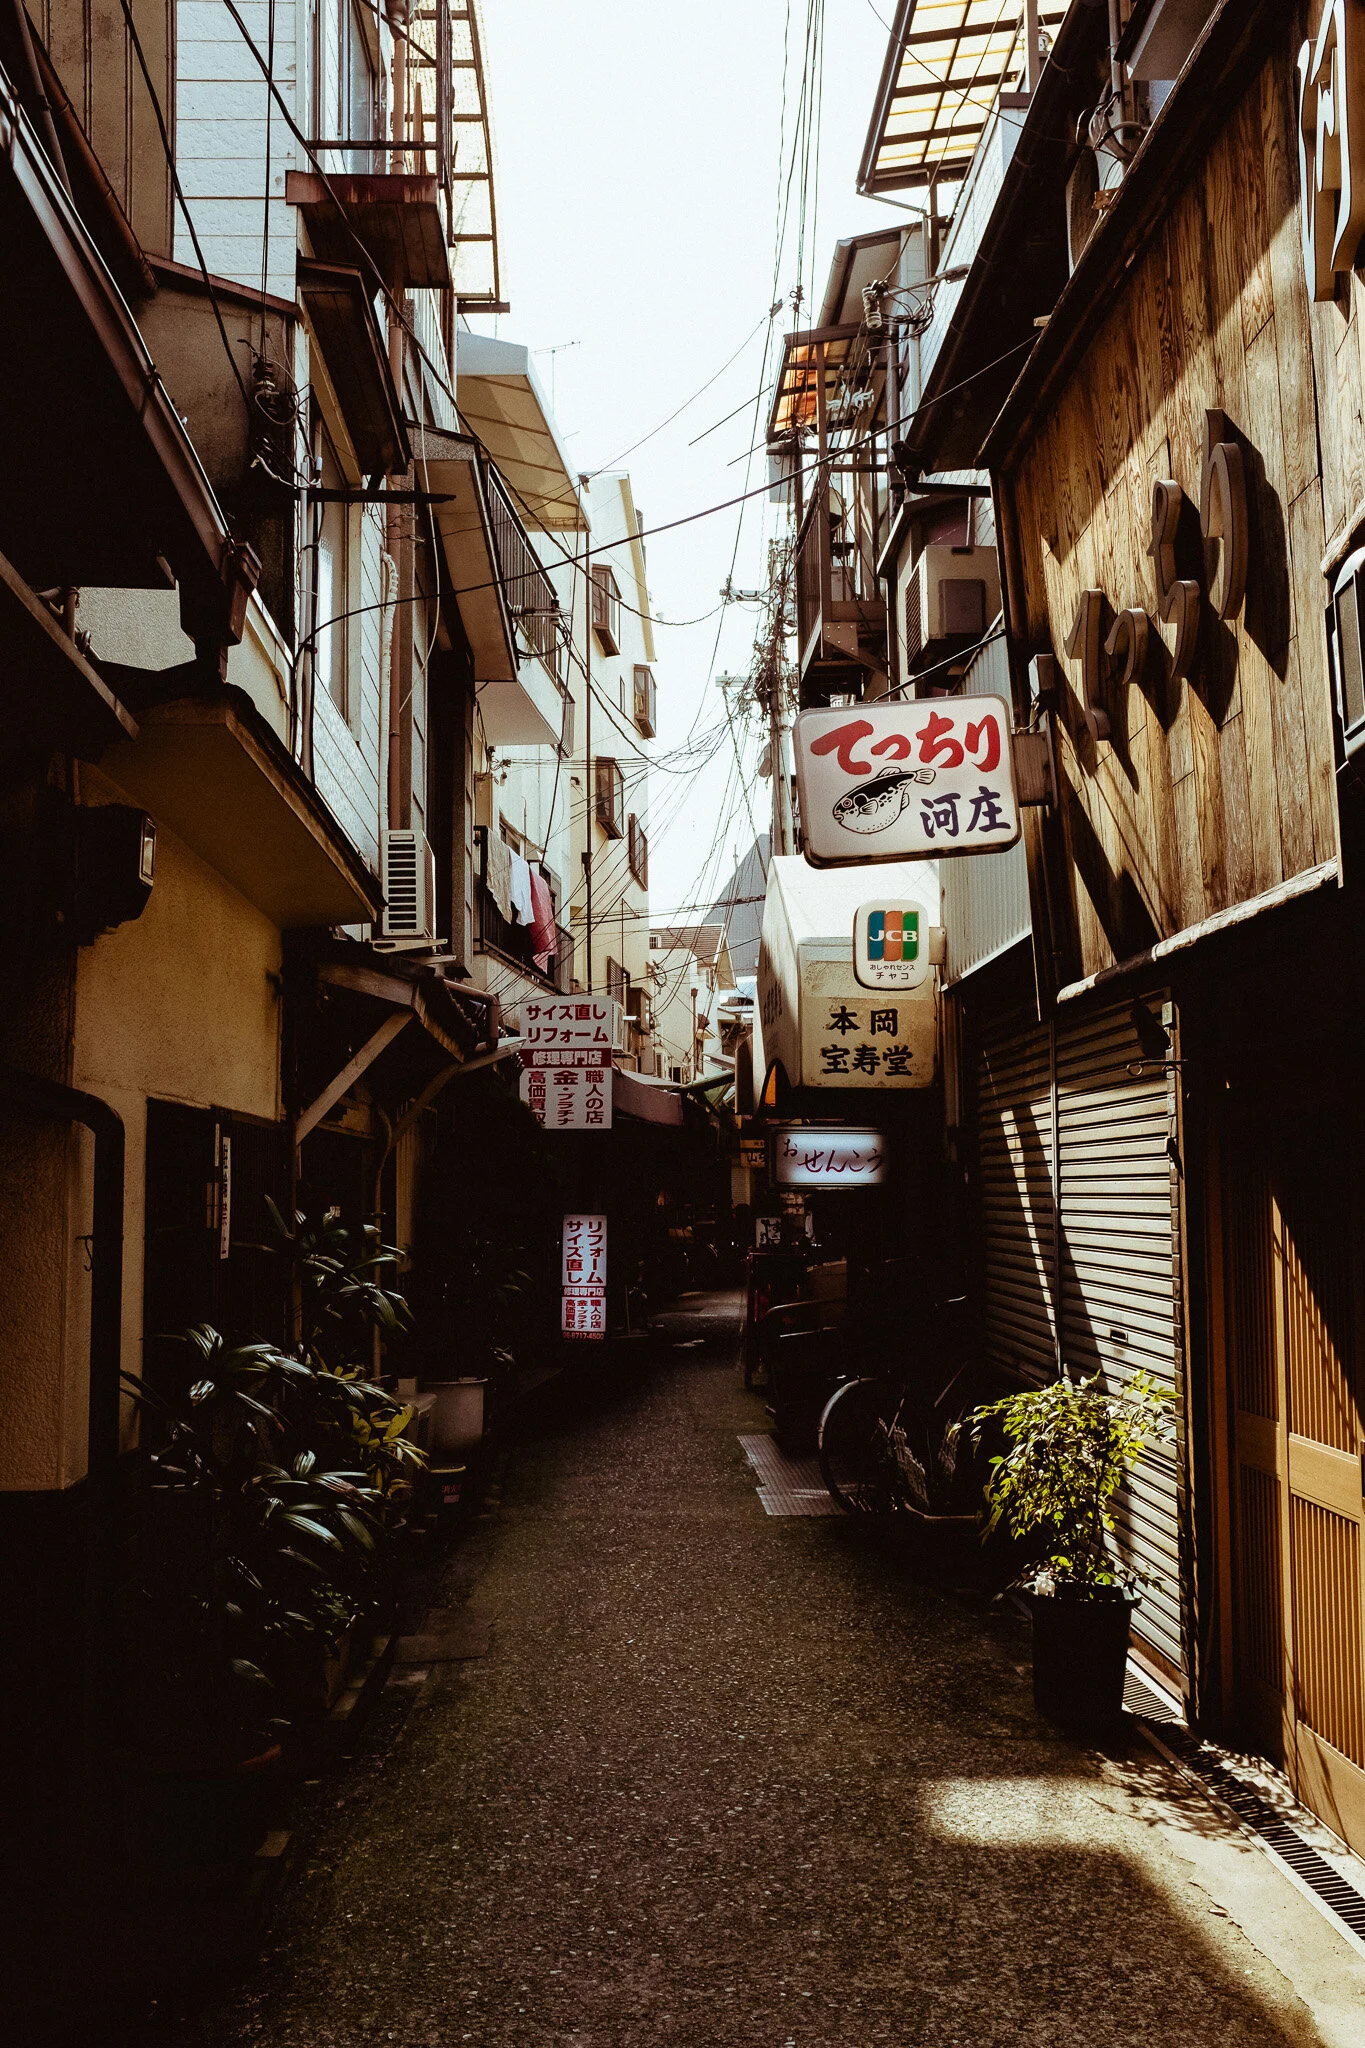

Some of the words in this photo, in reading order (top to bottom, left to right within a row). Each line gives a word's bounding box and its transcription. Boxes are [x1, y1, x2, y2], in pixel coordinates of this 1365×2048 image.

[810, 711, 1001, 775] てっちり
[919, 786, 1011, 838] 河庄
[870, 930, 917, 941] JCB
[869, 963, 916, 972] おしゃれセンス
[876, 972, 909, 980] チャコ
[526, 1004, 607, 1021] サイズ直し
[828, 1006, 898, 1037] 本岡
[528, 1026, 608, 1043] リフォーム
[532, 1050, 602, 1066] 修理専門店
[821, 1043, 913, 1077] 宝寿堂
[585, 1070, 604, 1124] 職人の店
[566, 1221, 584, 1284] サイズ直し
[586, 1221, 604, 1284] リフォーム
